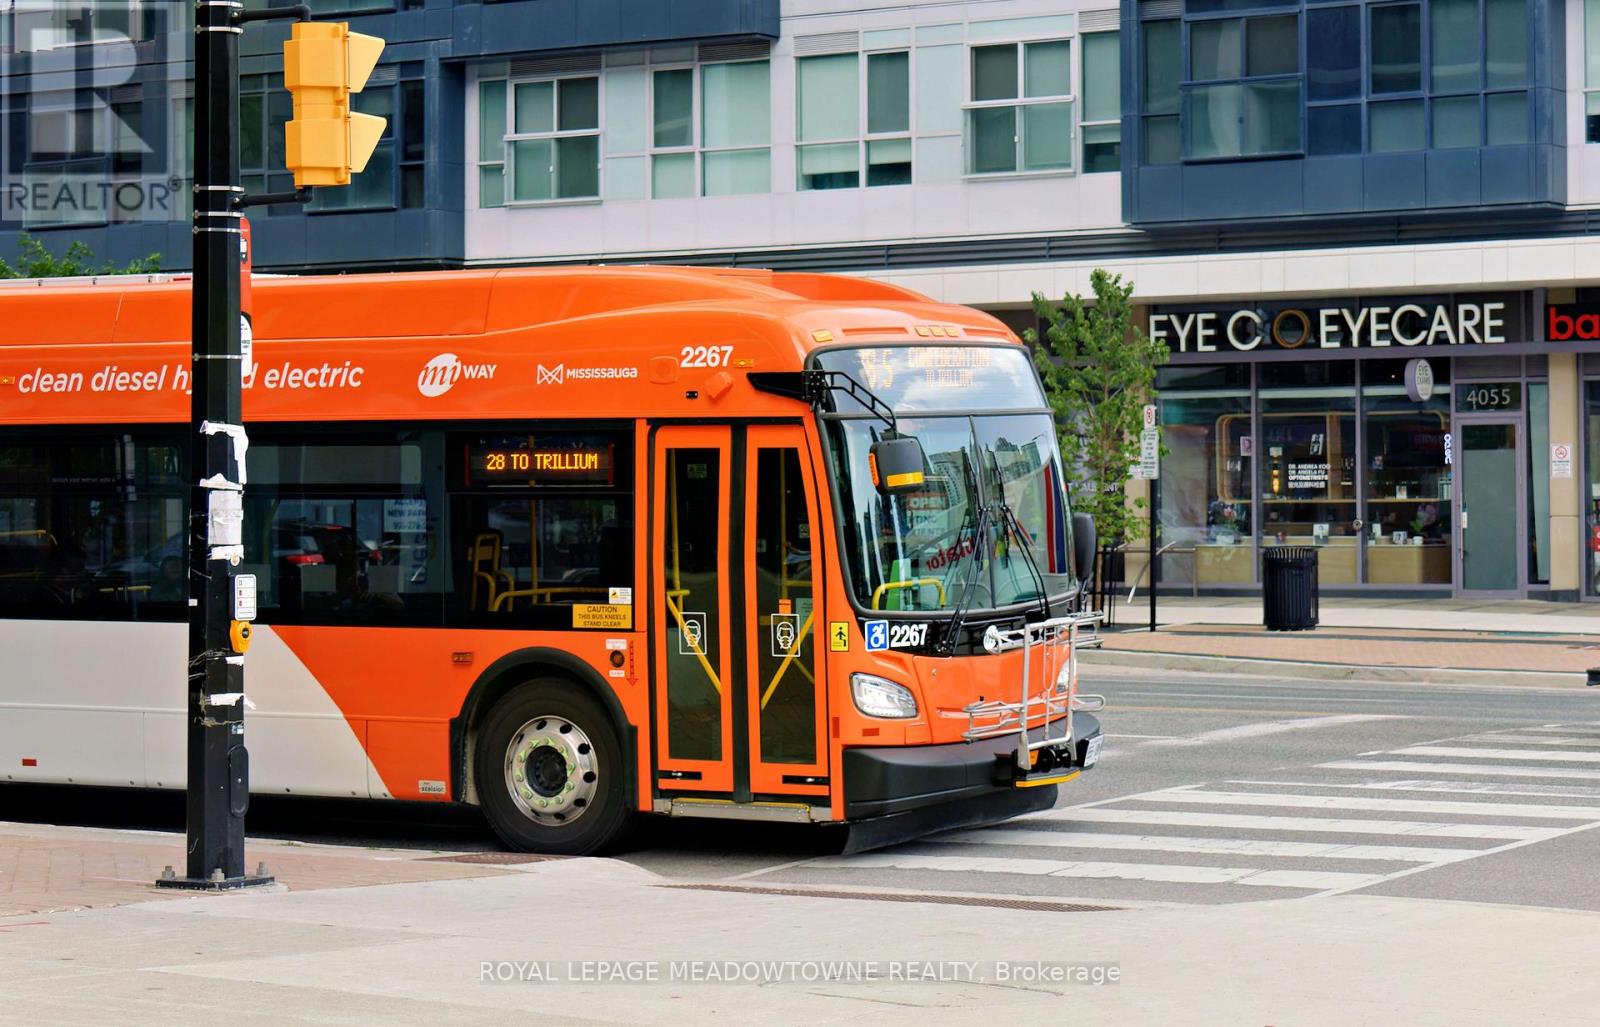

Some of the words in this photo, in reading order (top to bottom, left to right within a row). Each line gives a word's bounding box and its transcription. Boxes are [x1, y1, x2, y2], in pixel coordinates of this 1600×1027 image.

[1149, 312, 1217, 353] EYE
[1319, 302, 1506, 350] EYECARE
[680, 345, 735, 369] 2267
[18, 367, 83, 393] clean
[91, 364, 167, 391] diesel
[263, 361, 365, 390] electric
[1466, 388, 1511, 406] 4055
[486, 453, 505, 470] 28
[510, 453, 528, 470] TO
[534, 453, 598, 470] TRILLIUM
[890, 623, 928, 648] 2267
